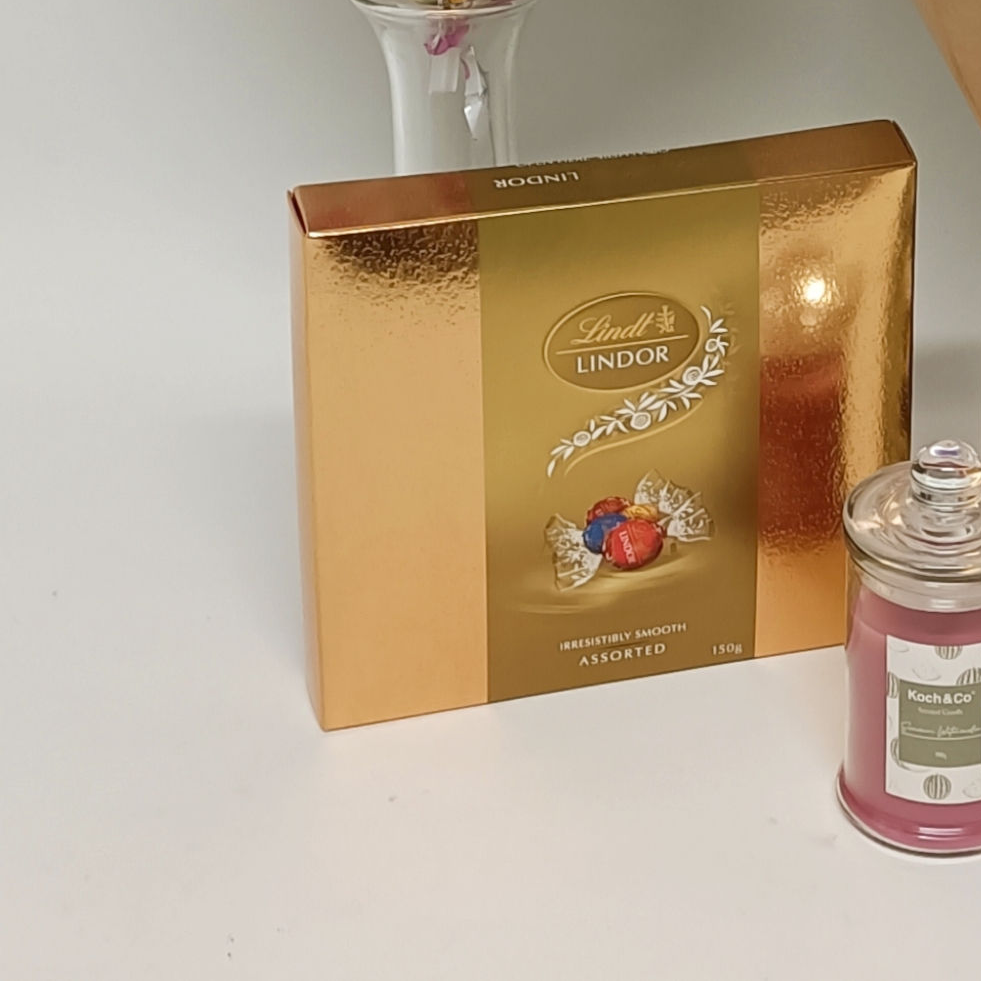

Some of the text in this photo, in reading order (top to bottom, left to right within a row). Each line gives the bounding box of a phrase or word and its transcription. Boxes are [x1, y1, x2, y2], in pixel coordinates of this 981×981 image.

[494, 171, 580, 189] LINDOR
[570, 312, 655, 345] Lindt
[577, 345, 670, 374] LINDOR
[560, 622, 687, 651] IRRESISTIBLY SMOOTH
[712, 642, 744, 656] 150g
[578, 643, 667, 667] ASSORTED
